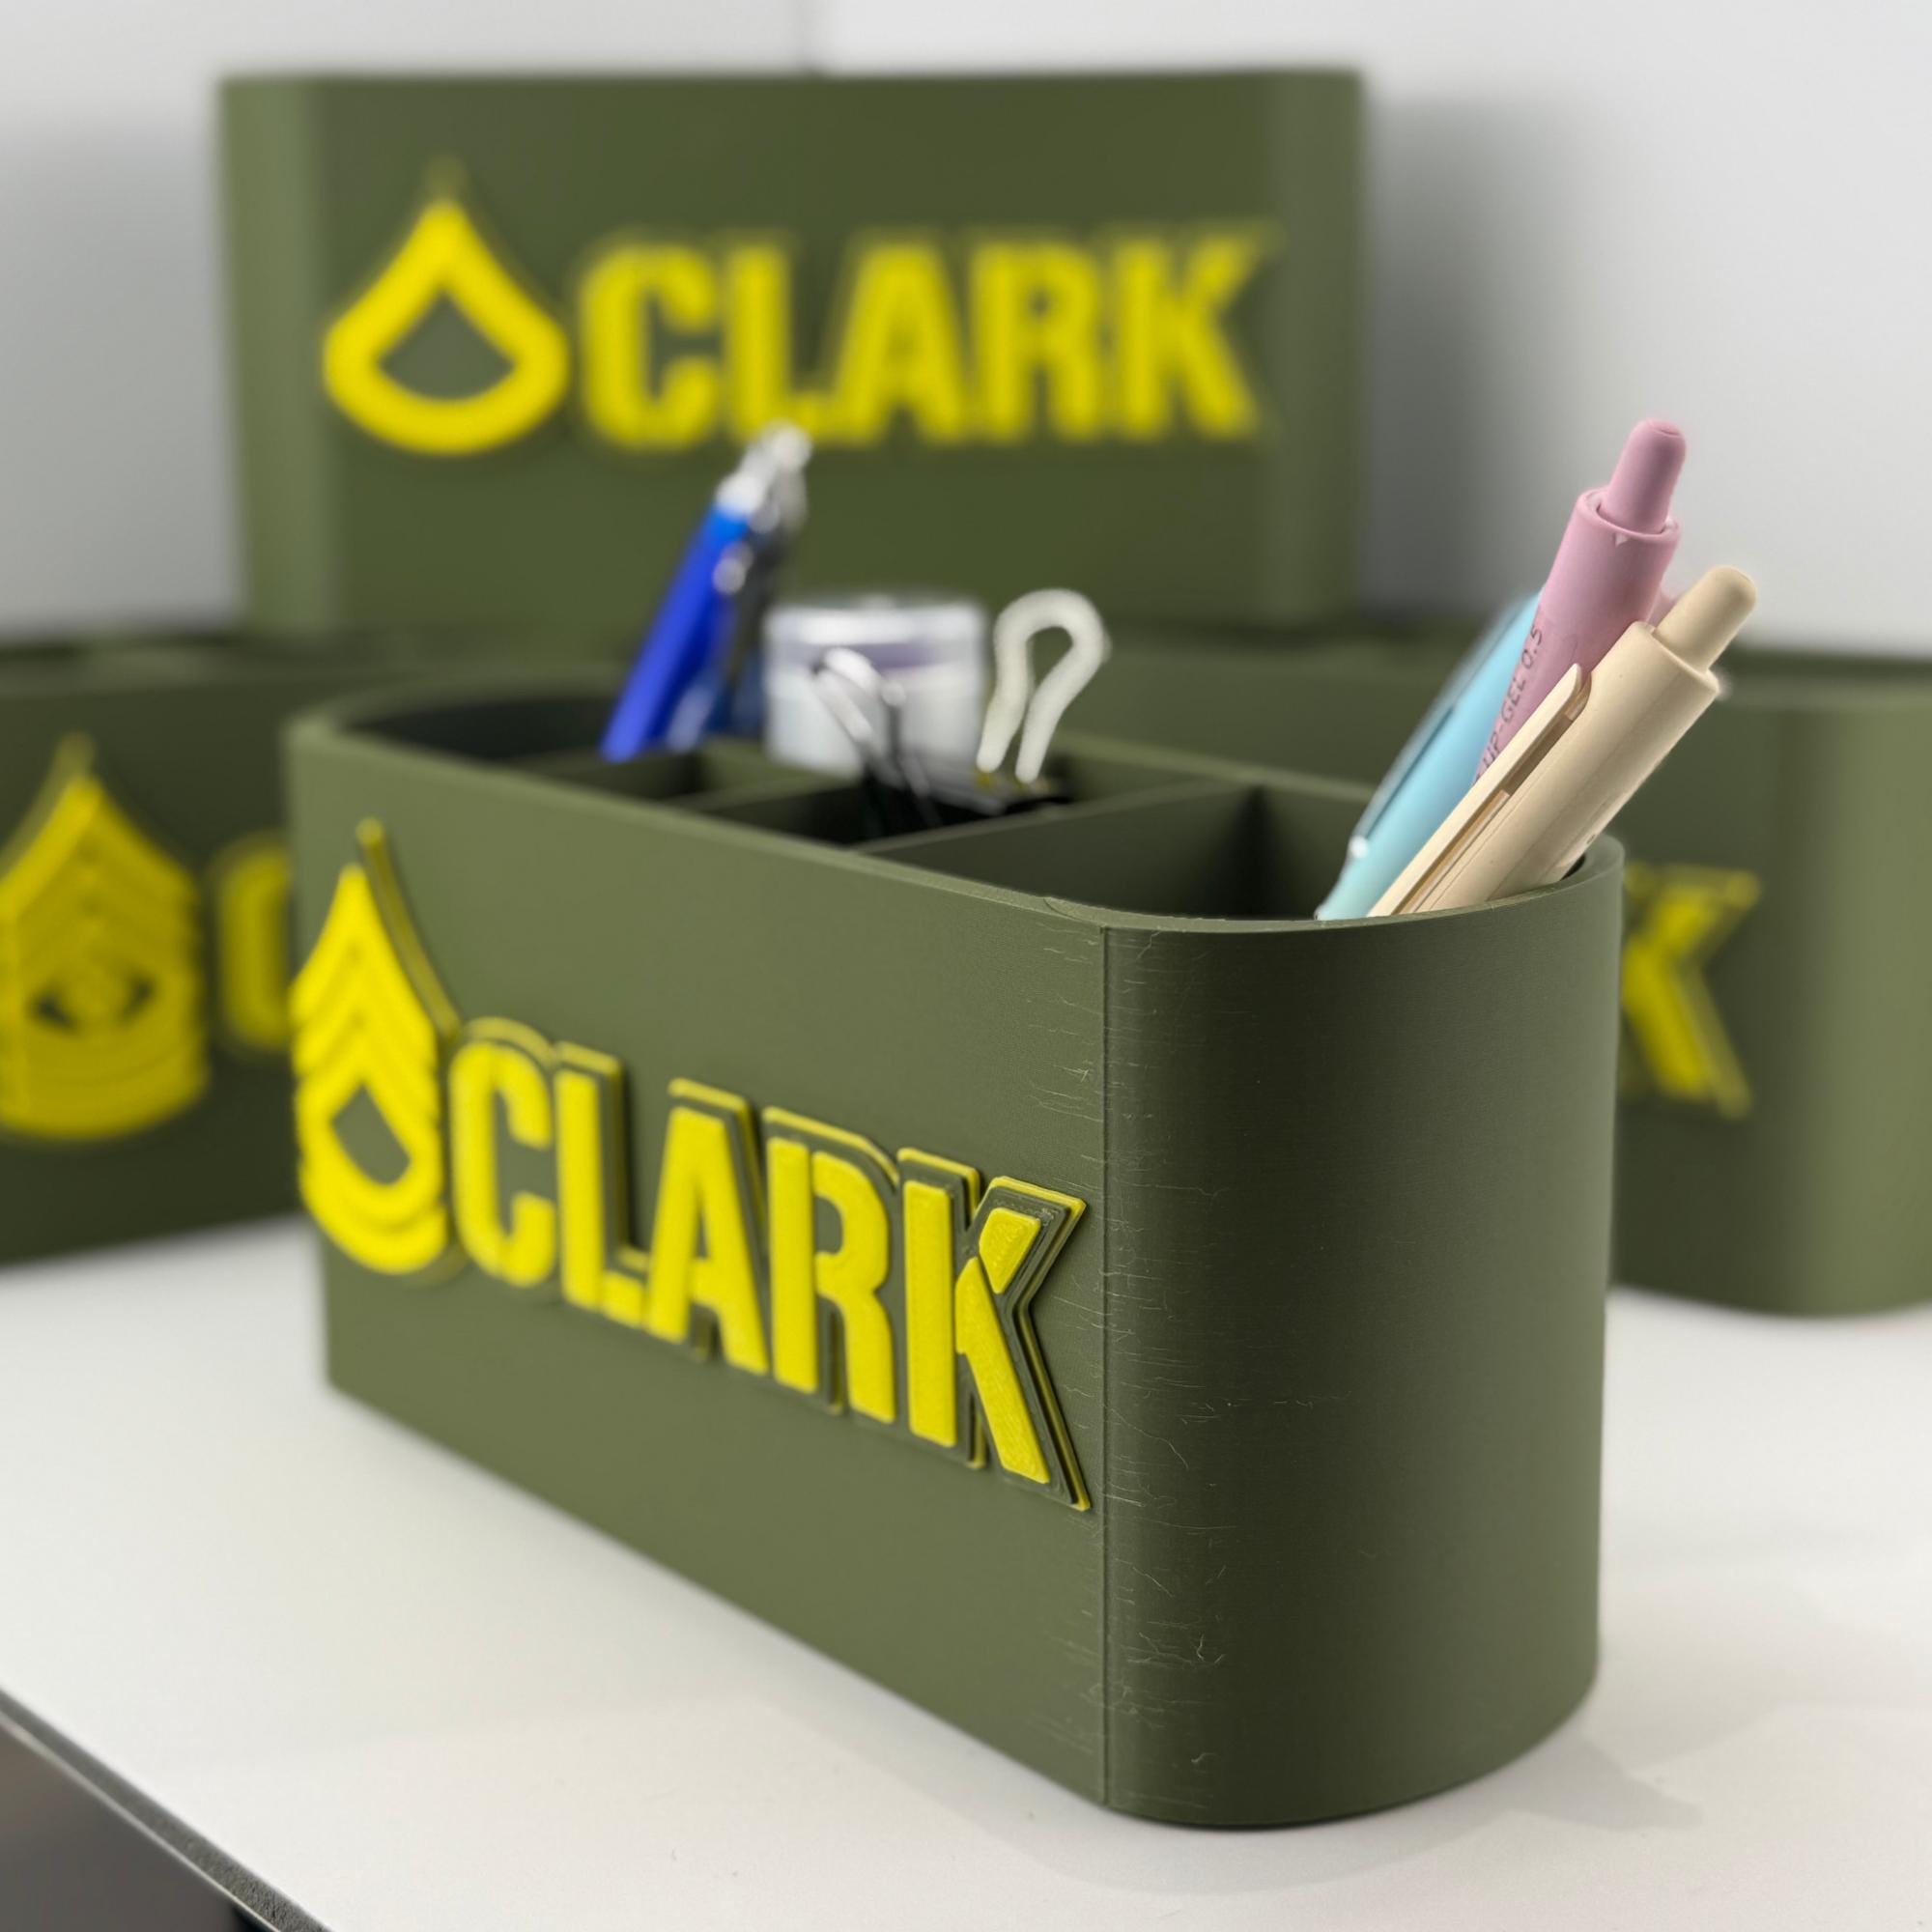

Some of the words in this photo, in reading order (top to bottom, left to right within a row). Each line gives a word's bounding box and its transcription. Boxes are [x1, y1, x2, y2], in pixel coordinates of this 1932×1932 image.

[579, 230, 1269, 447] CLARK
[1521, 623, 1543, 668] 0.5
[450, 1020, 1092, 1509] CLARK
